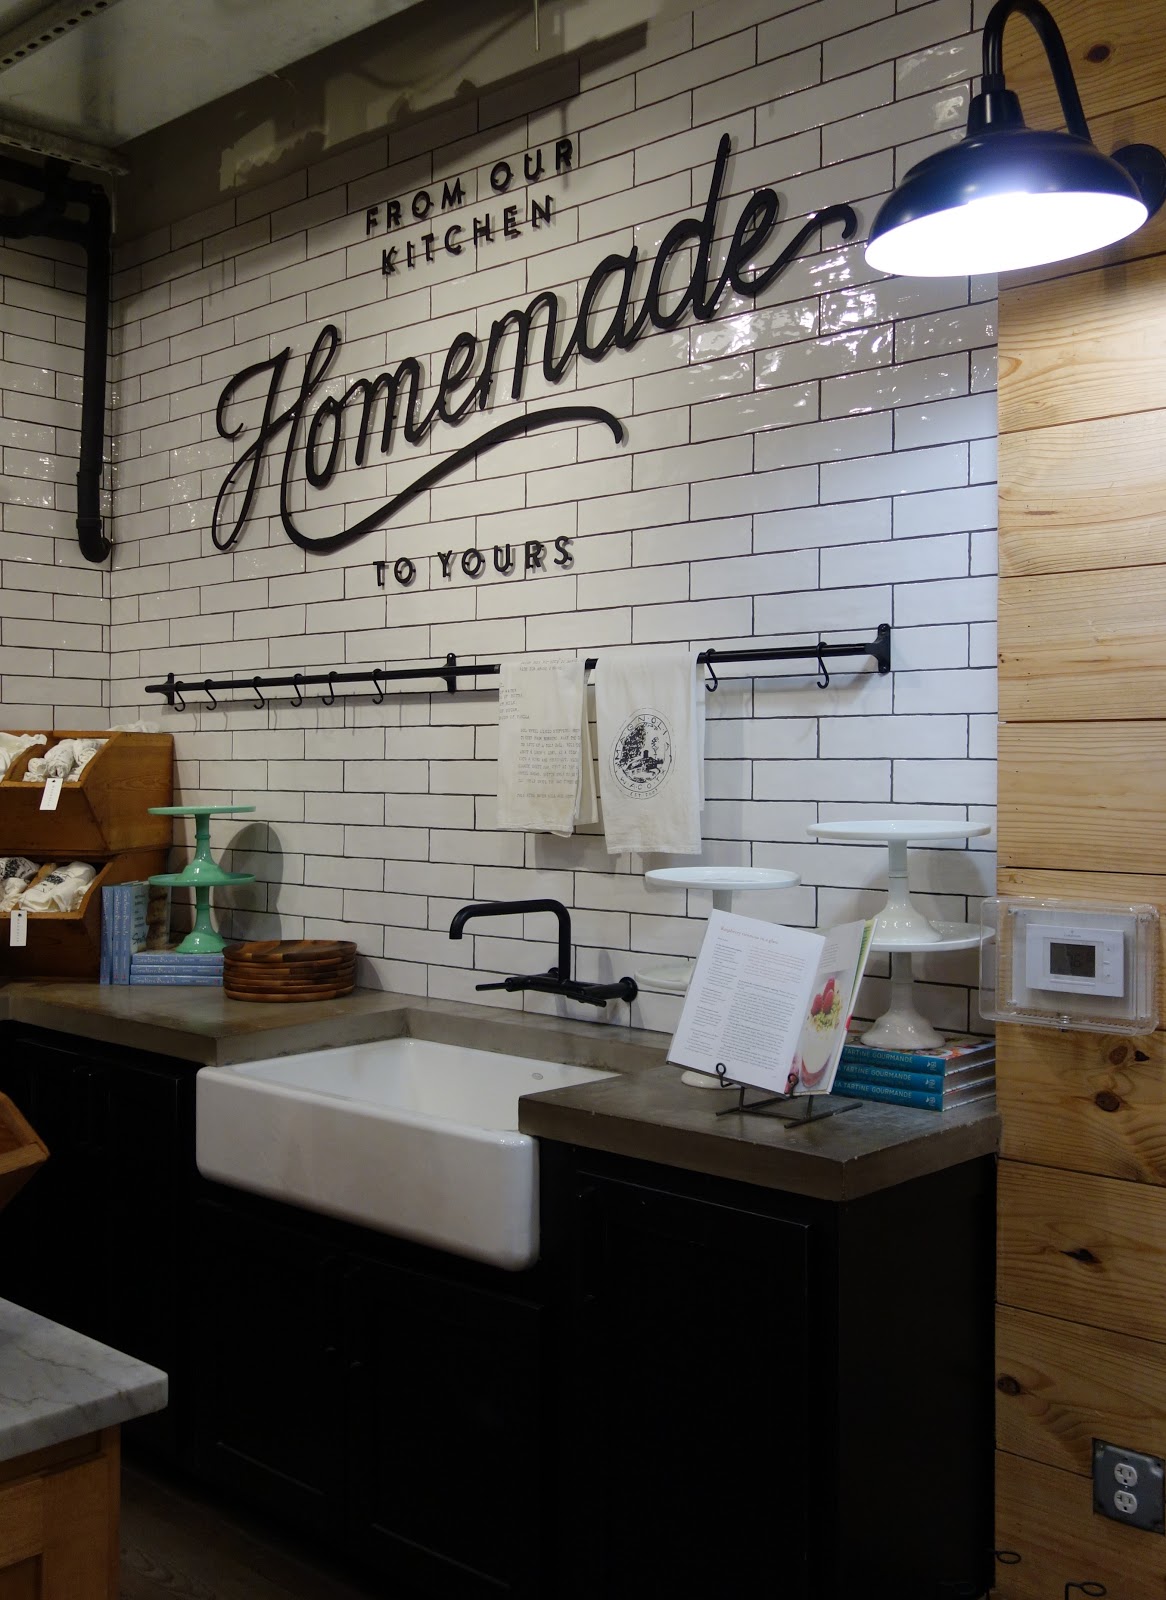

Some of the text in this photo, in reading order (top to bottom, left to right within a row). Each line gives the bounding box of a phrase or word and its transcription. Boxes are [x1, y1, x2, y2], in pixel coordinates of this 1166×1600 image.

[365, 138, 574, 236] FROM OUR
[381, 195, 555, 276] KITCHEN
[212, 133, 856, 553] Homemade
[373, 535, 574, 589] TO YOURS
[843, 1065, 869, 1075] TARTINE
[870, 1068, 912, 1080] GOURMANDE
[872, 1050, 913, 1064] GOURMANDE
[843, 1082, 870, 1093] TARTINE
[871, 1086, 913, 1099] GOURMANDE
